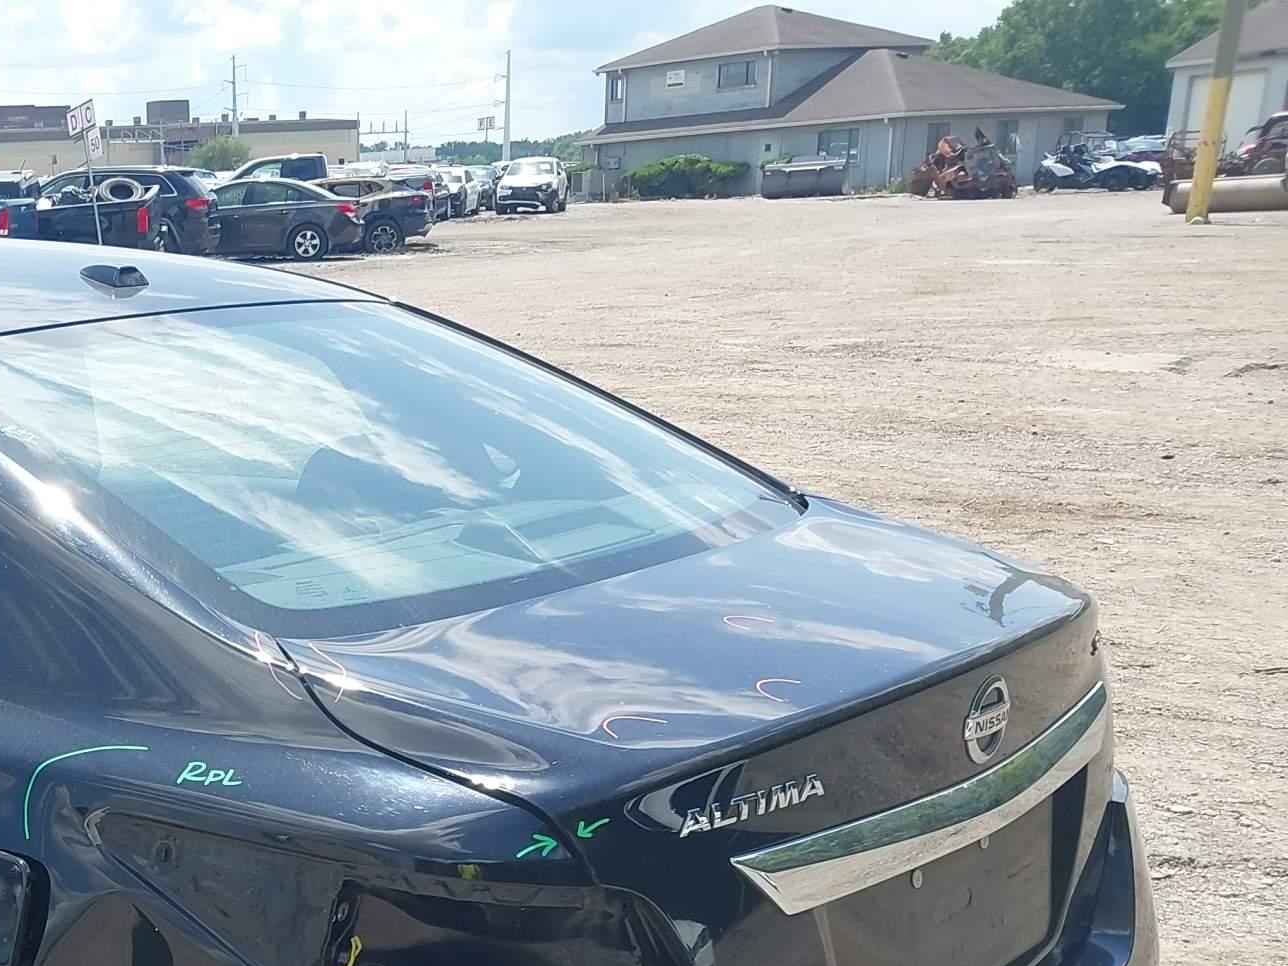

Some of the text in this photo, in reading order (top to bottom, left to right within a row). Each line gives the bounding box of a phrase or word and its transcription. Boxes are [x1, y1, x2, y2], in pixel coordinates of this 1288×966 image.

[71, 106, 92, 131] D C
[90, 135, 100, 153] 50
[679, 773, 825, 838] ALTIMA
